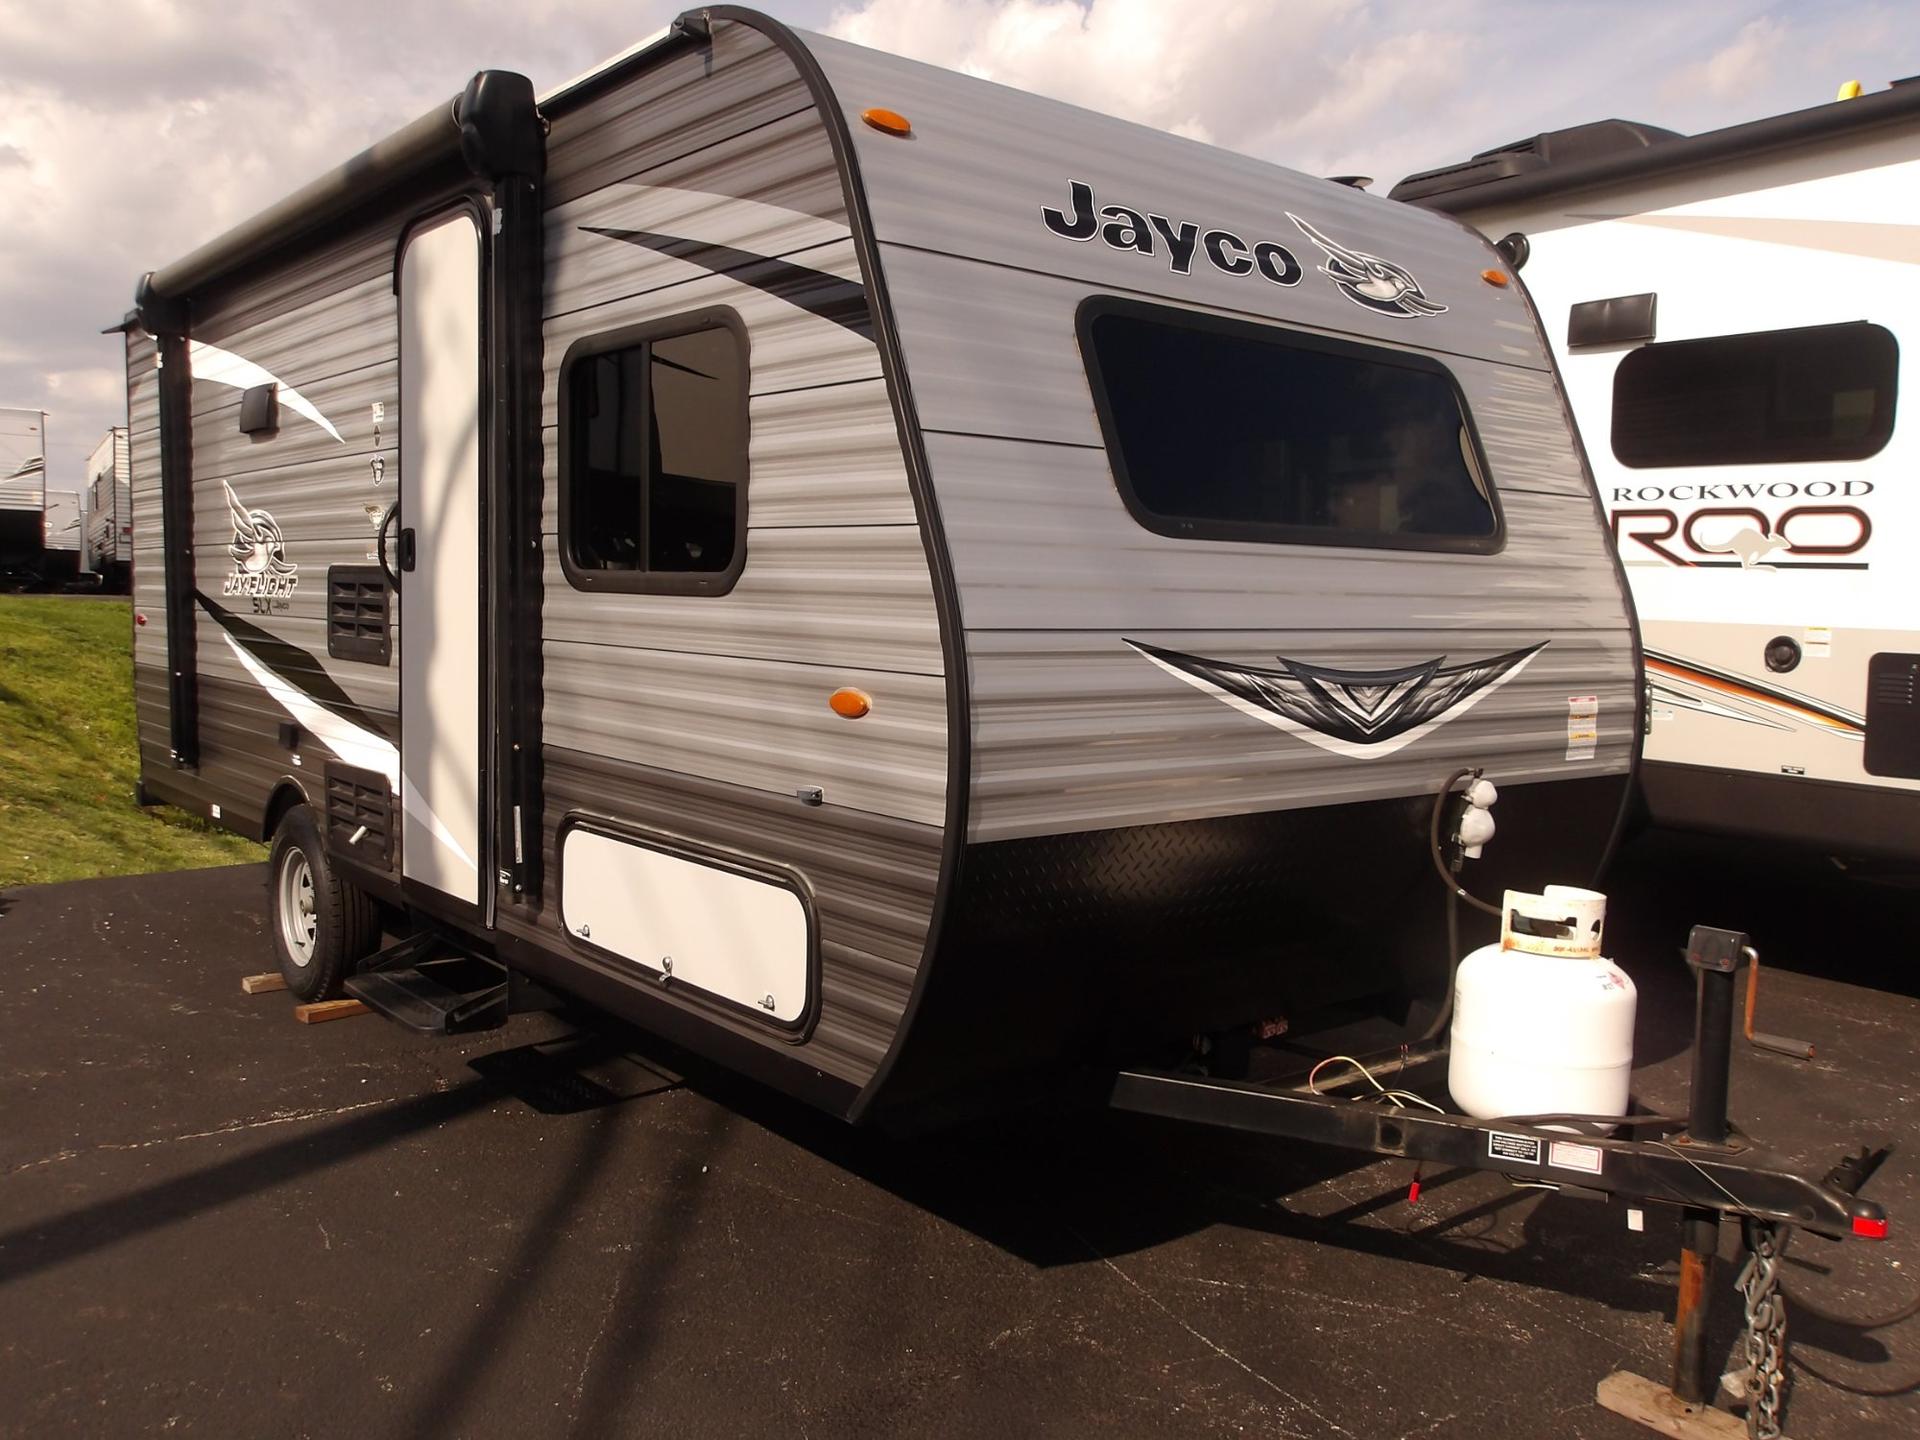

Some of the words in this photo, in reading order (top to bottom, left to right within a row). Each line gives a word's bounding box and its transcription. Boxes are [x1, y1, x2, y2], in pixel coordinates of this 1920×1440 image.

[1040, 178, 1304, 288] Jayco
[1612, 480, 1875, 501] ROCKWOOD
[1611, 505, 1873, 567] ROO
[253, 596, 272, 615] SLX
